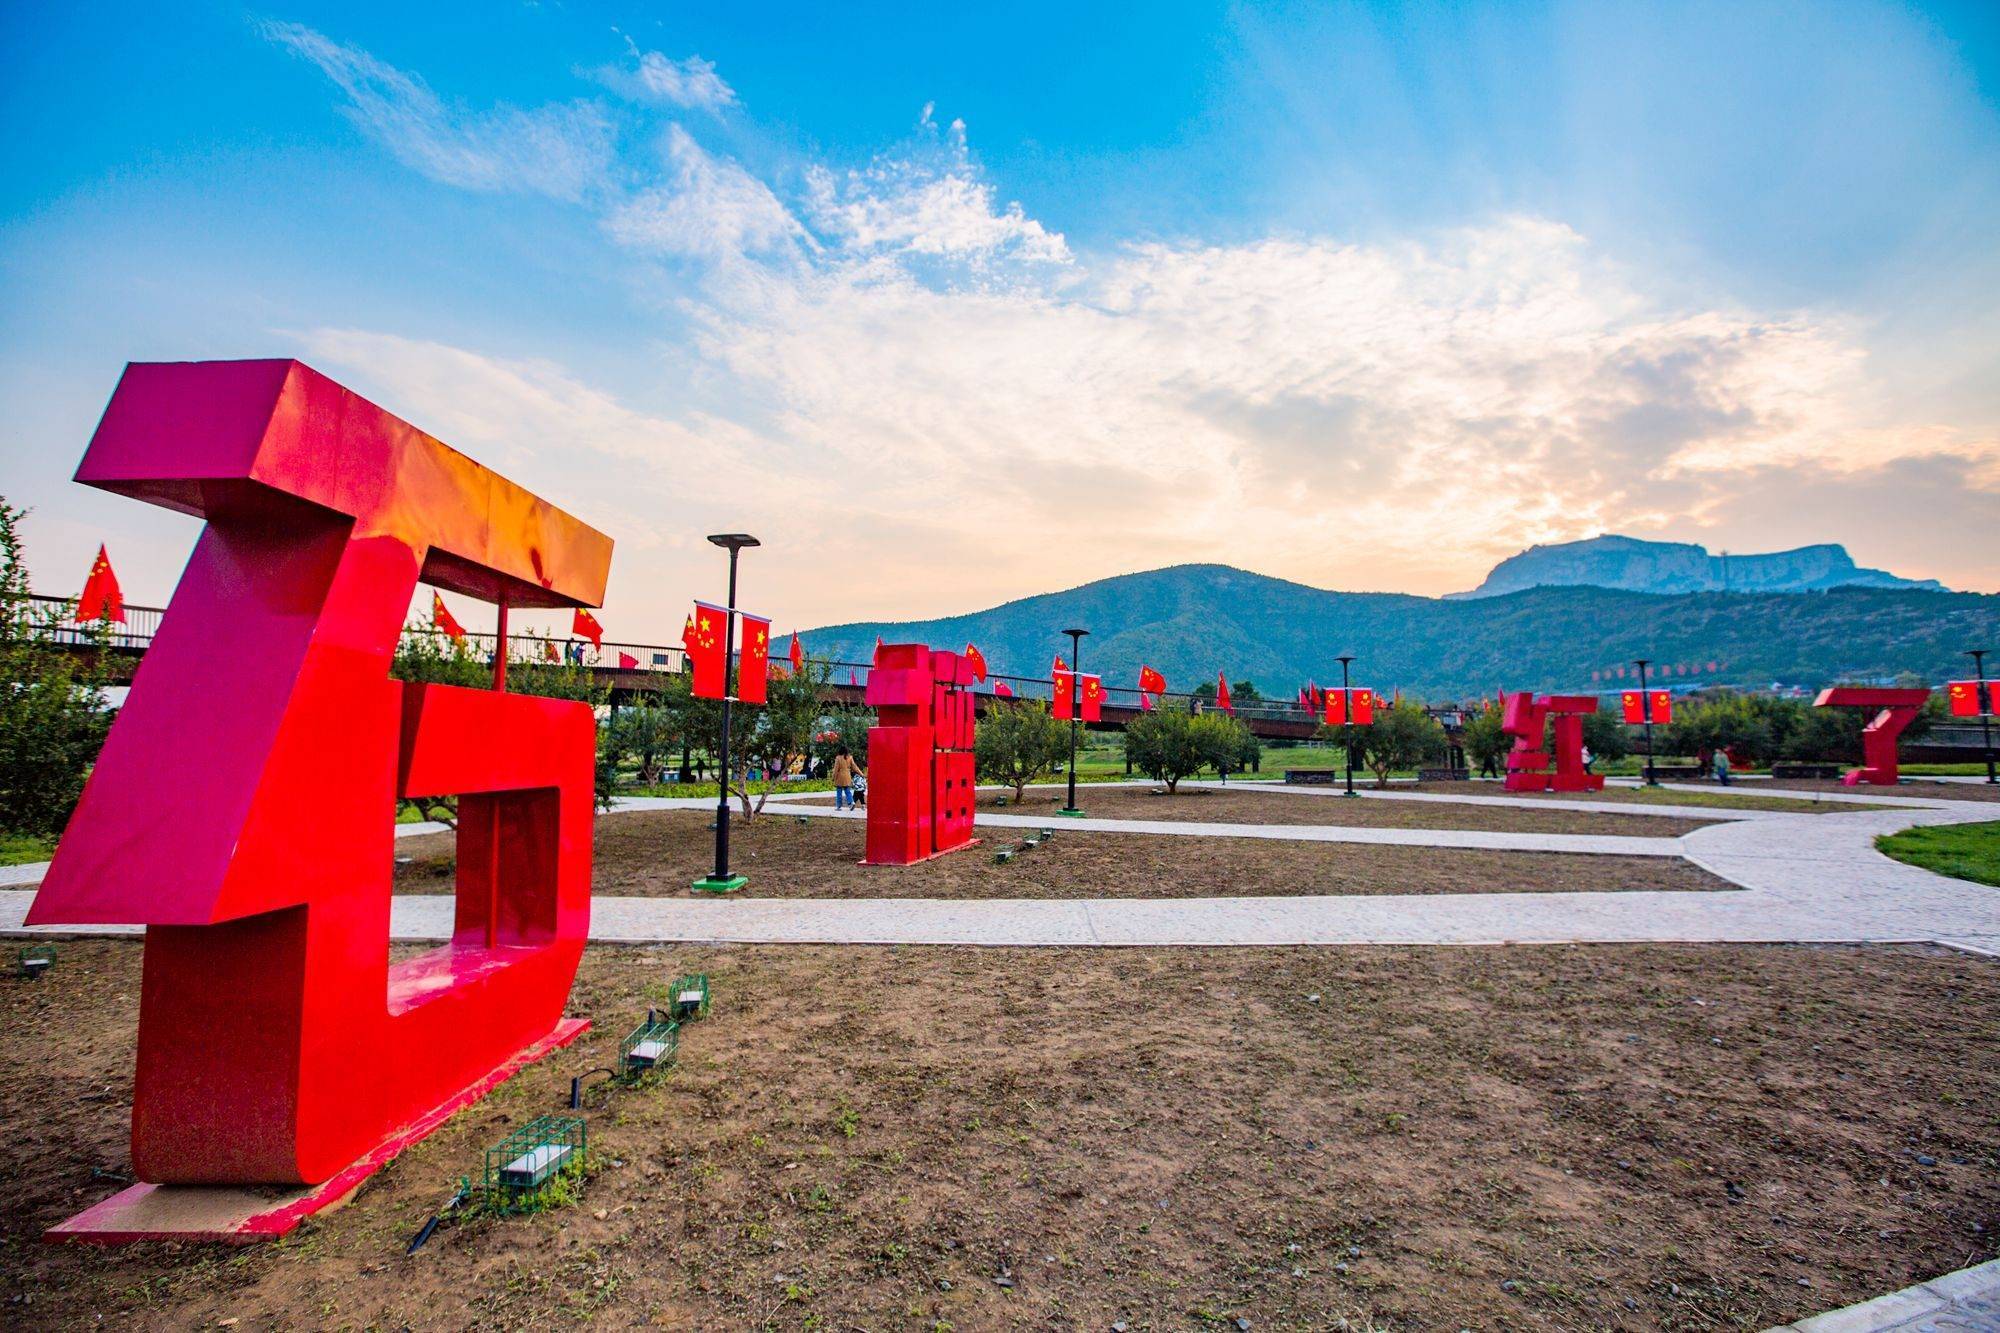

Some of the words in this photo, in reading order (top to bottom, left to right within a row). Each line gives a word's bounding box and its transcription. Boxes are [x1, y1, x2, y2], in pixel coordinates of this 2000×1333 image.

[28, 358, 614, 1187] 石
[1502, 692, 1604, 792] 红
[1812, 688, 1930, 786] 了
